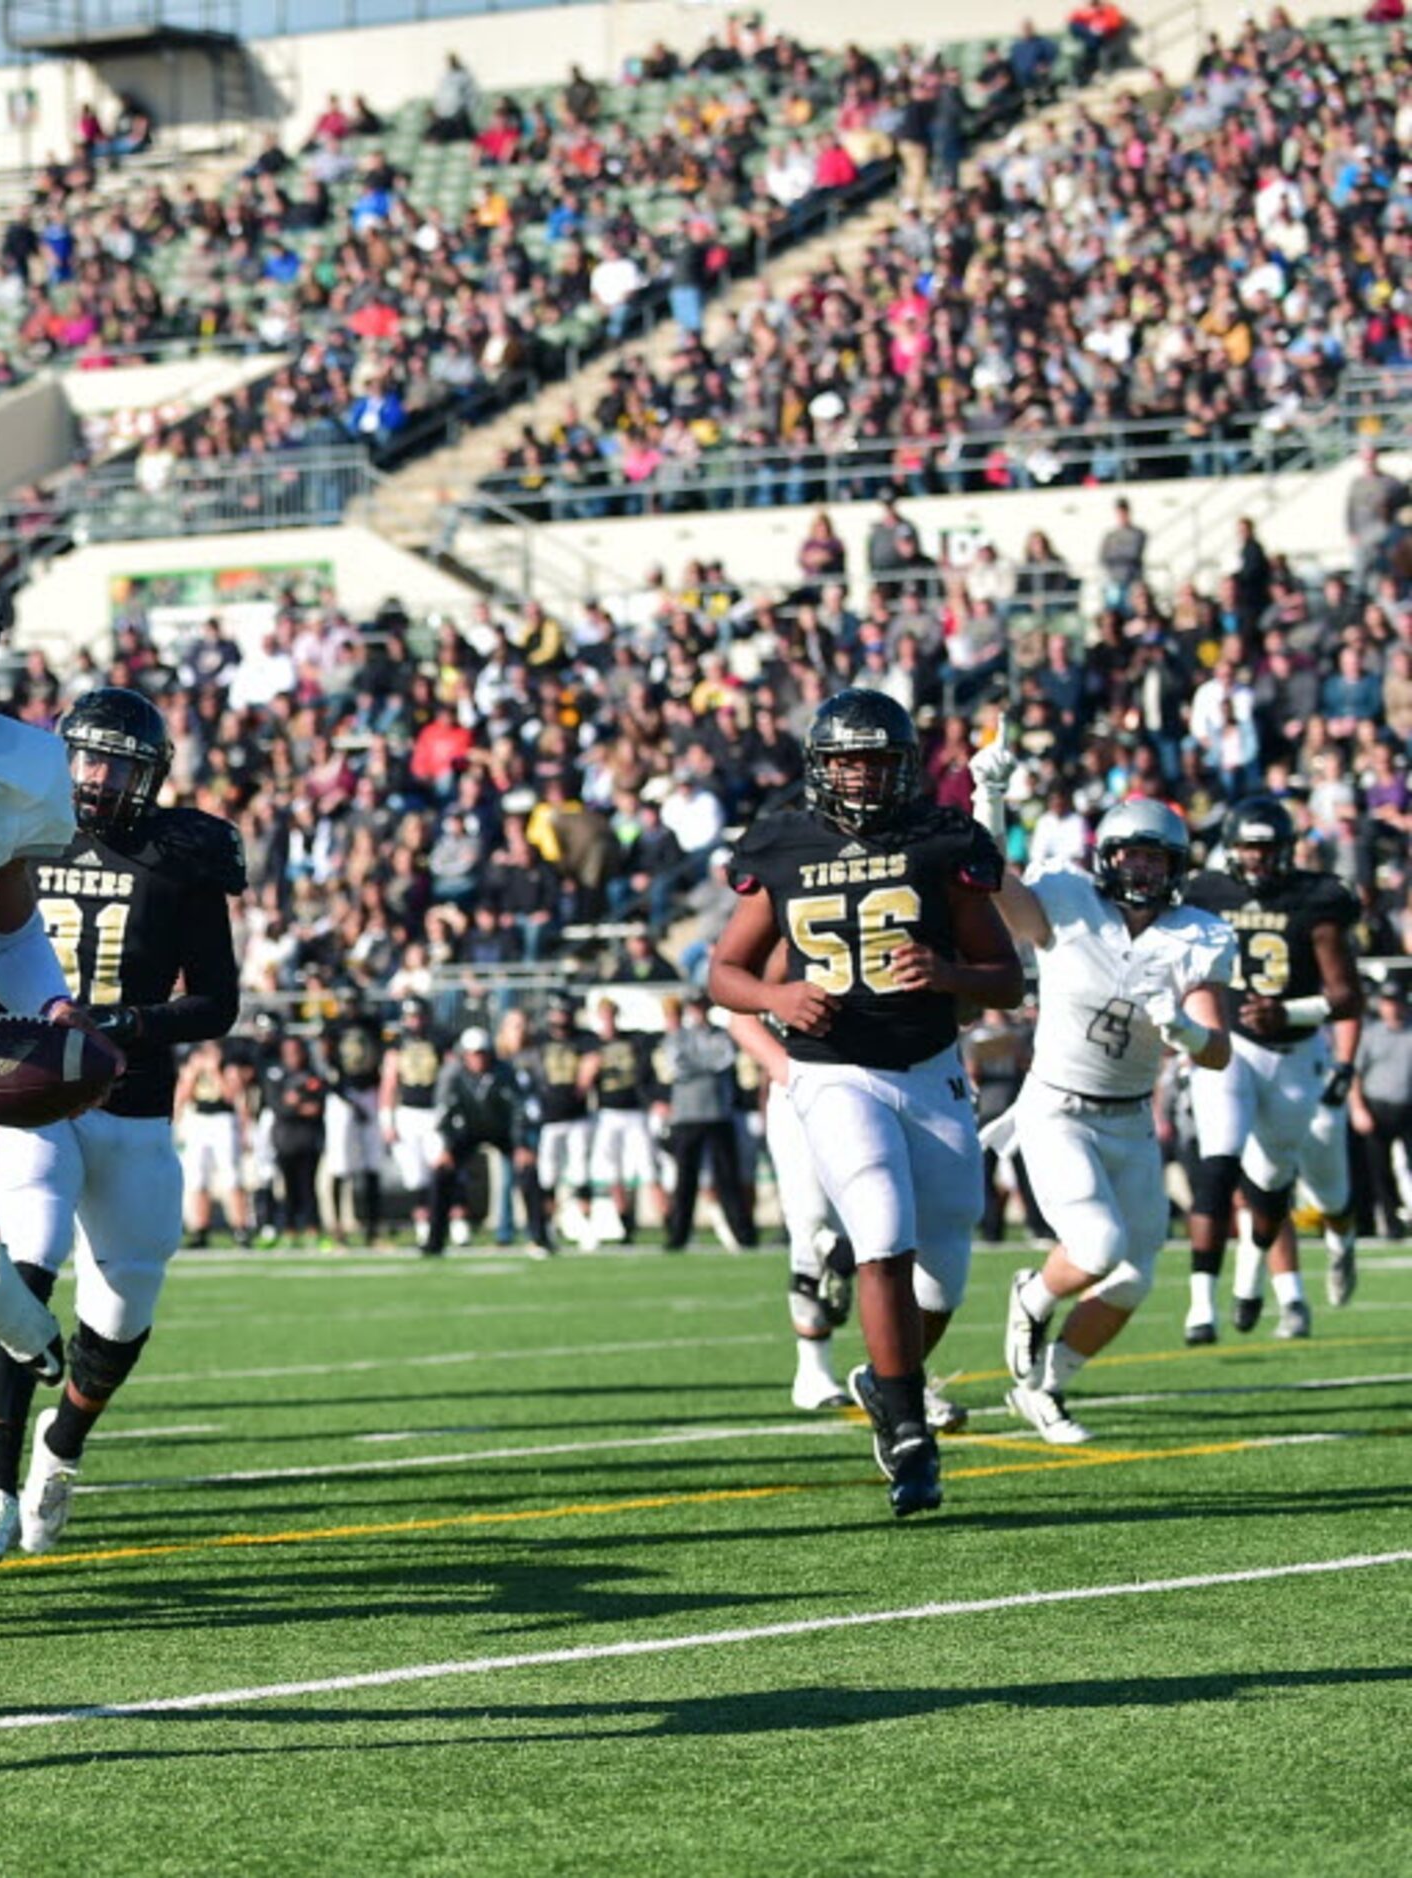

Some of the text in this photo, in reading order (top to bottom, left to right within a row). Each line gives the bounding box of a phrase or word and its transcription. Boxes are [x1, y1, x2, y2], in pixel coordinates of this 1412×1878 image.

[38, 866, 134, 898] TIGERS
[799, 854, 908, 889] TIGERS
[787, 885, 919, 995] 56
[1086, 998, 1135, 1059] 4
